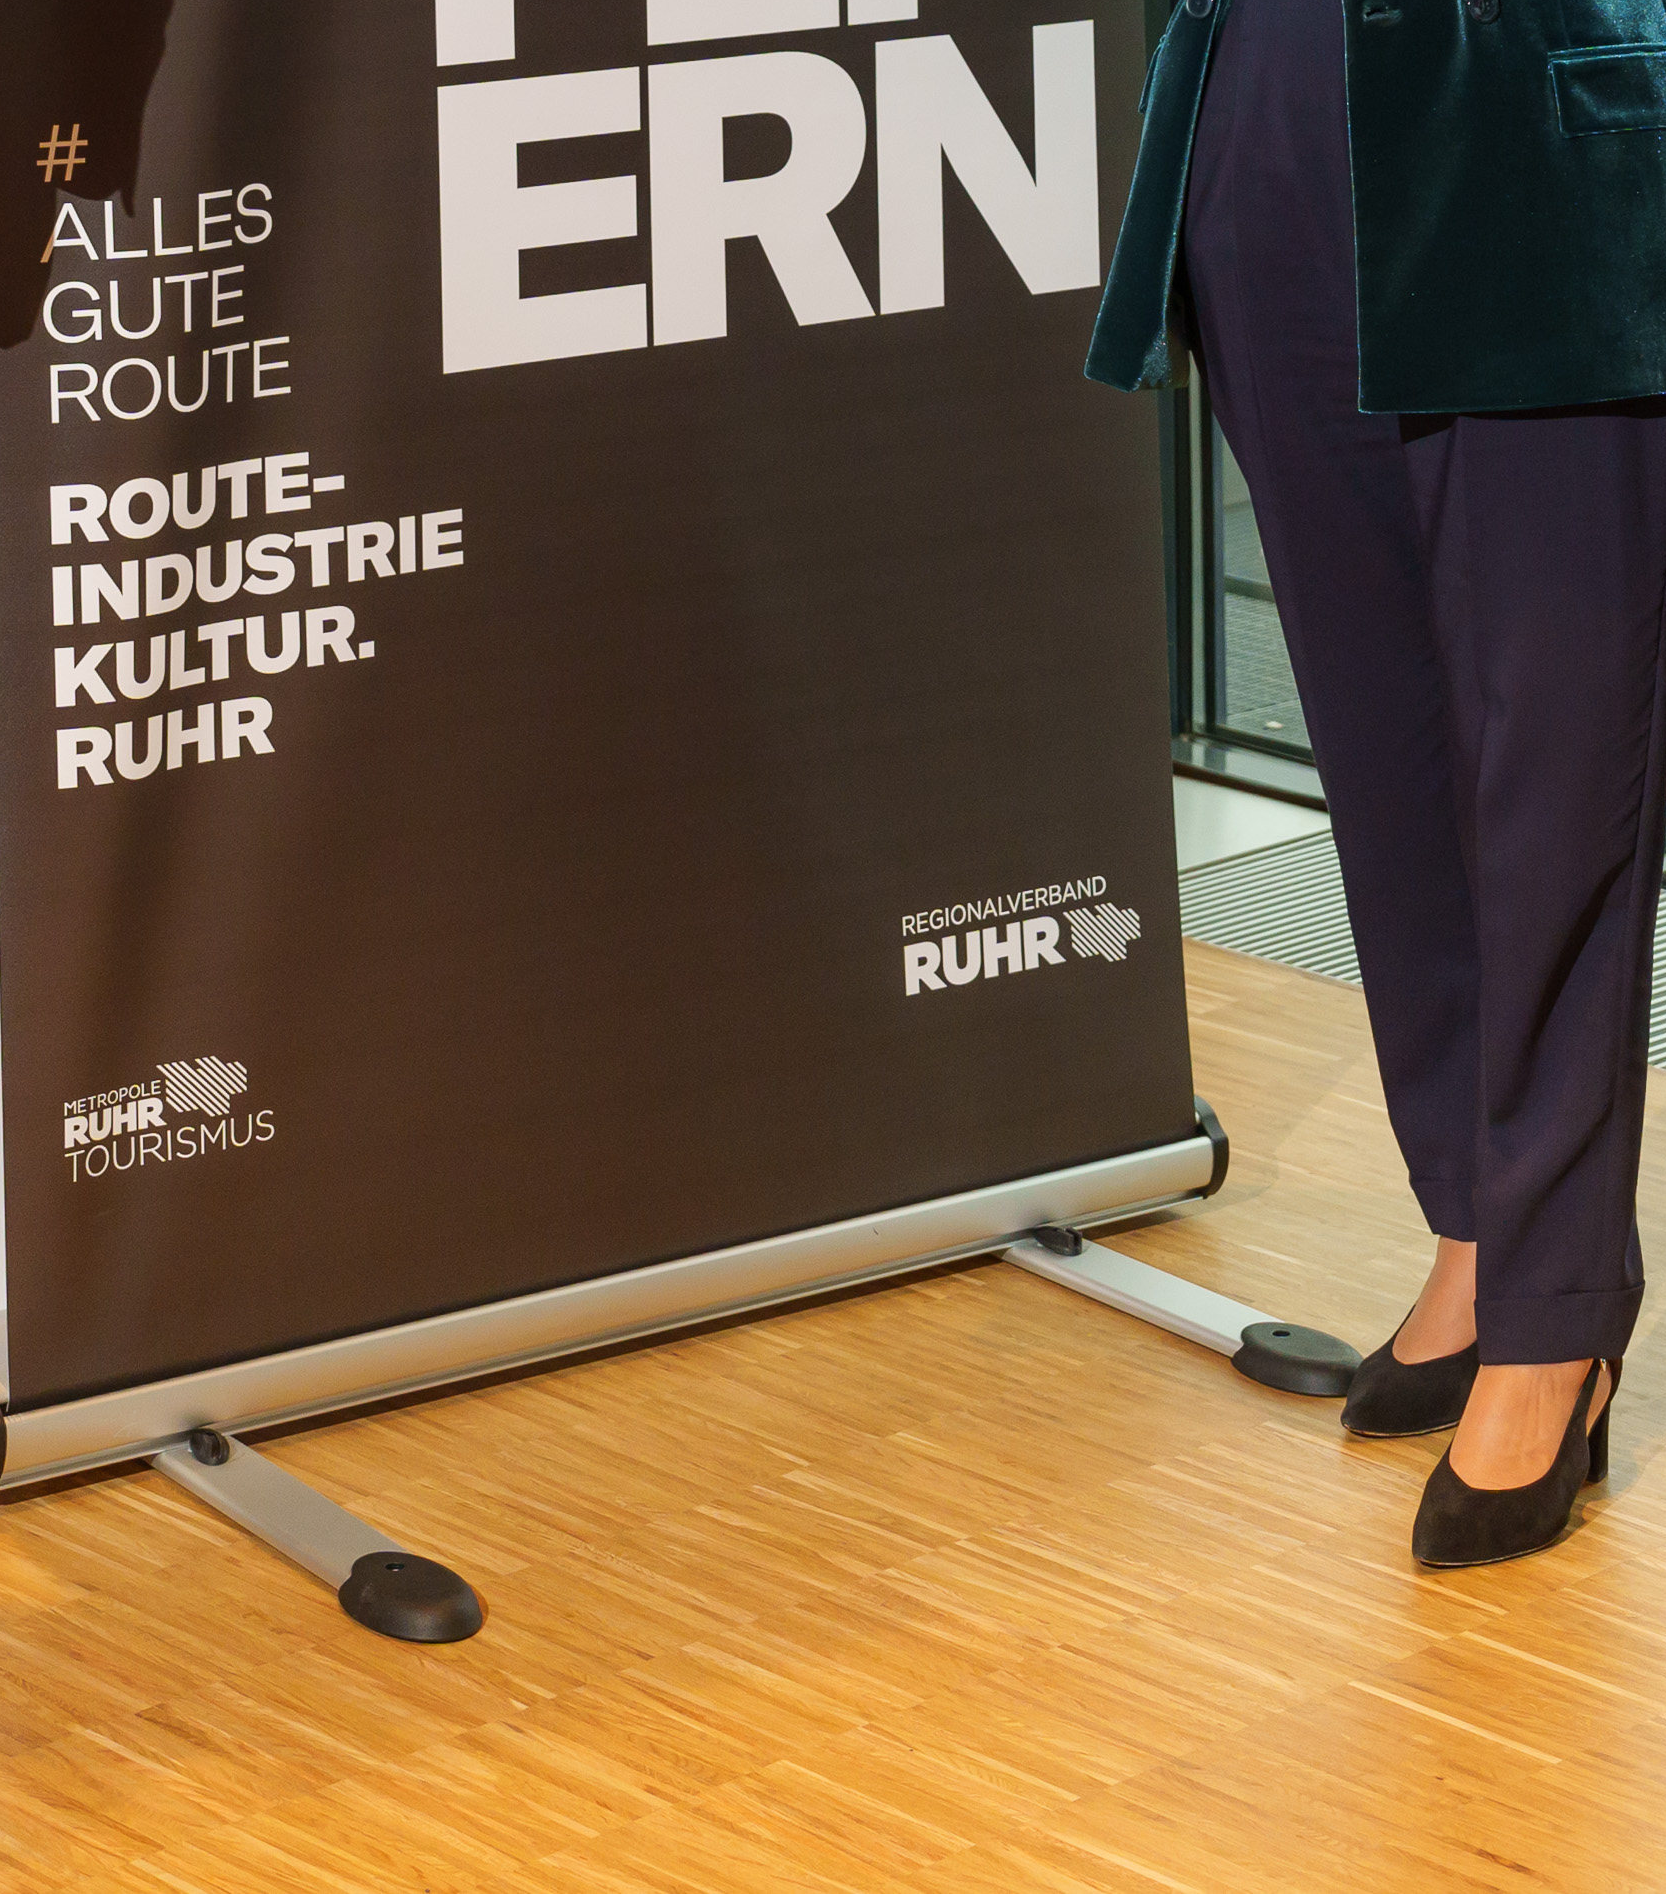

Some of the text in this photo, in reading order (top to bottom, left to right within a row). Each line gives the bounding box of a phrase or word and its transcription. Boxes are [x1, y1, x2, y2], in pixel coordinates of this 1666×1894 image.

[37, 124, 88, 182] #
[41, 183, 273, 263] ALLES
[437, 19, 1101, 374] ERN
[42, 265, 245, 344] GUTE
[49, 336, 291, 424] ROUTE
[50, 451, 345, 545] ROUTE-
[51, 508, 464, 626] INDUSTRIE
[53, 605, 375, 708] KULTUR.
[56, 696, 275, 790] RUHR
[902, 875, 1107, 937] REGIONALVERBAND
[904, 915, 1066, 996] RUHR
[64, 1079, 162, 1117] METROPOLE
[64, 1096, 167, 1149] RUHR
[64, 1109, 276, 1183] TOURISMUS
